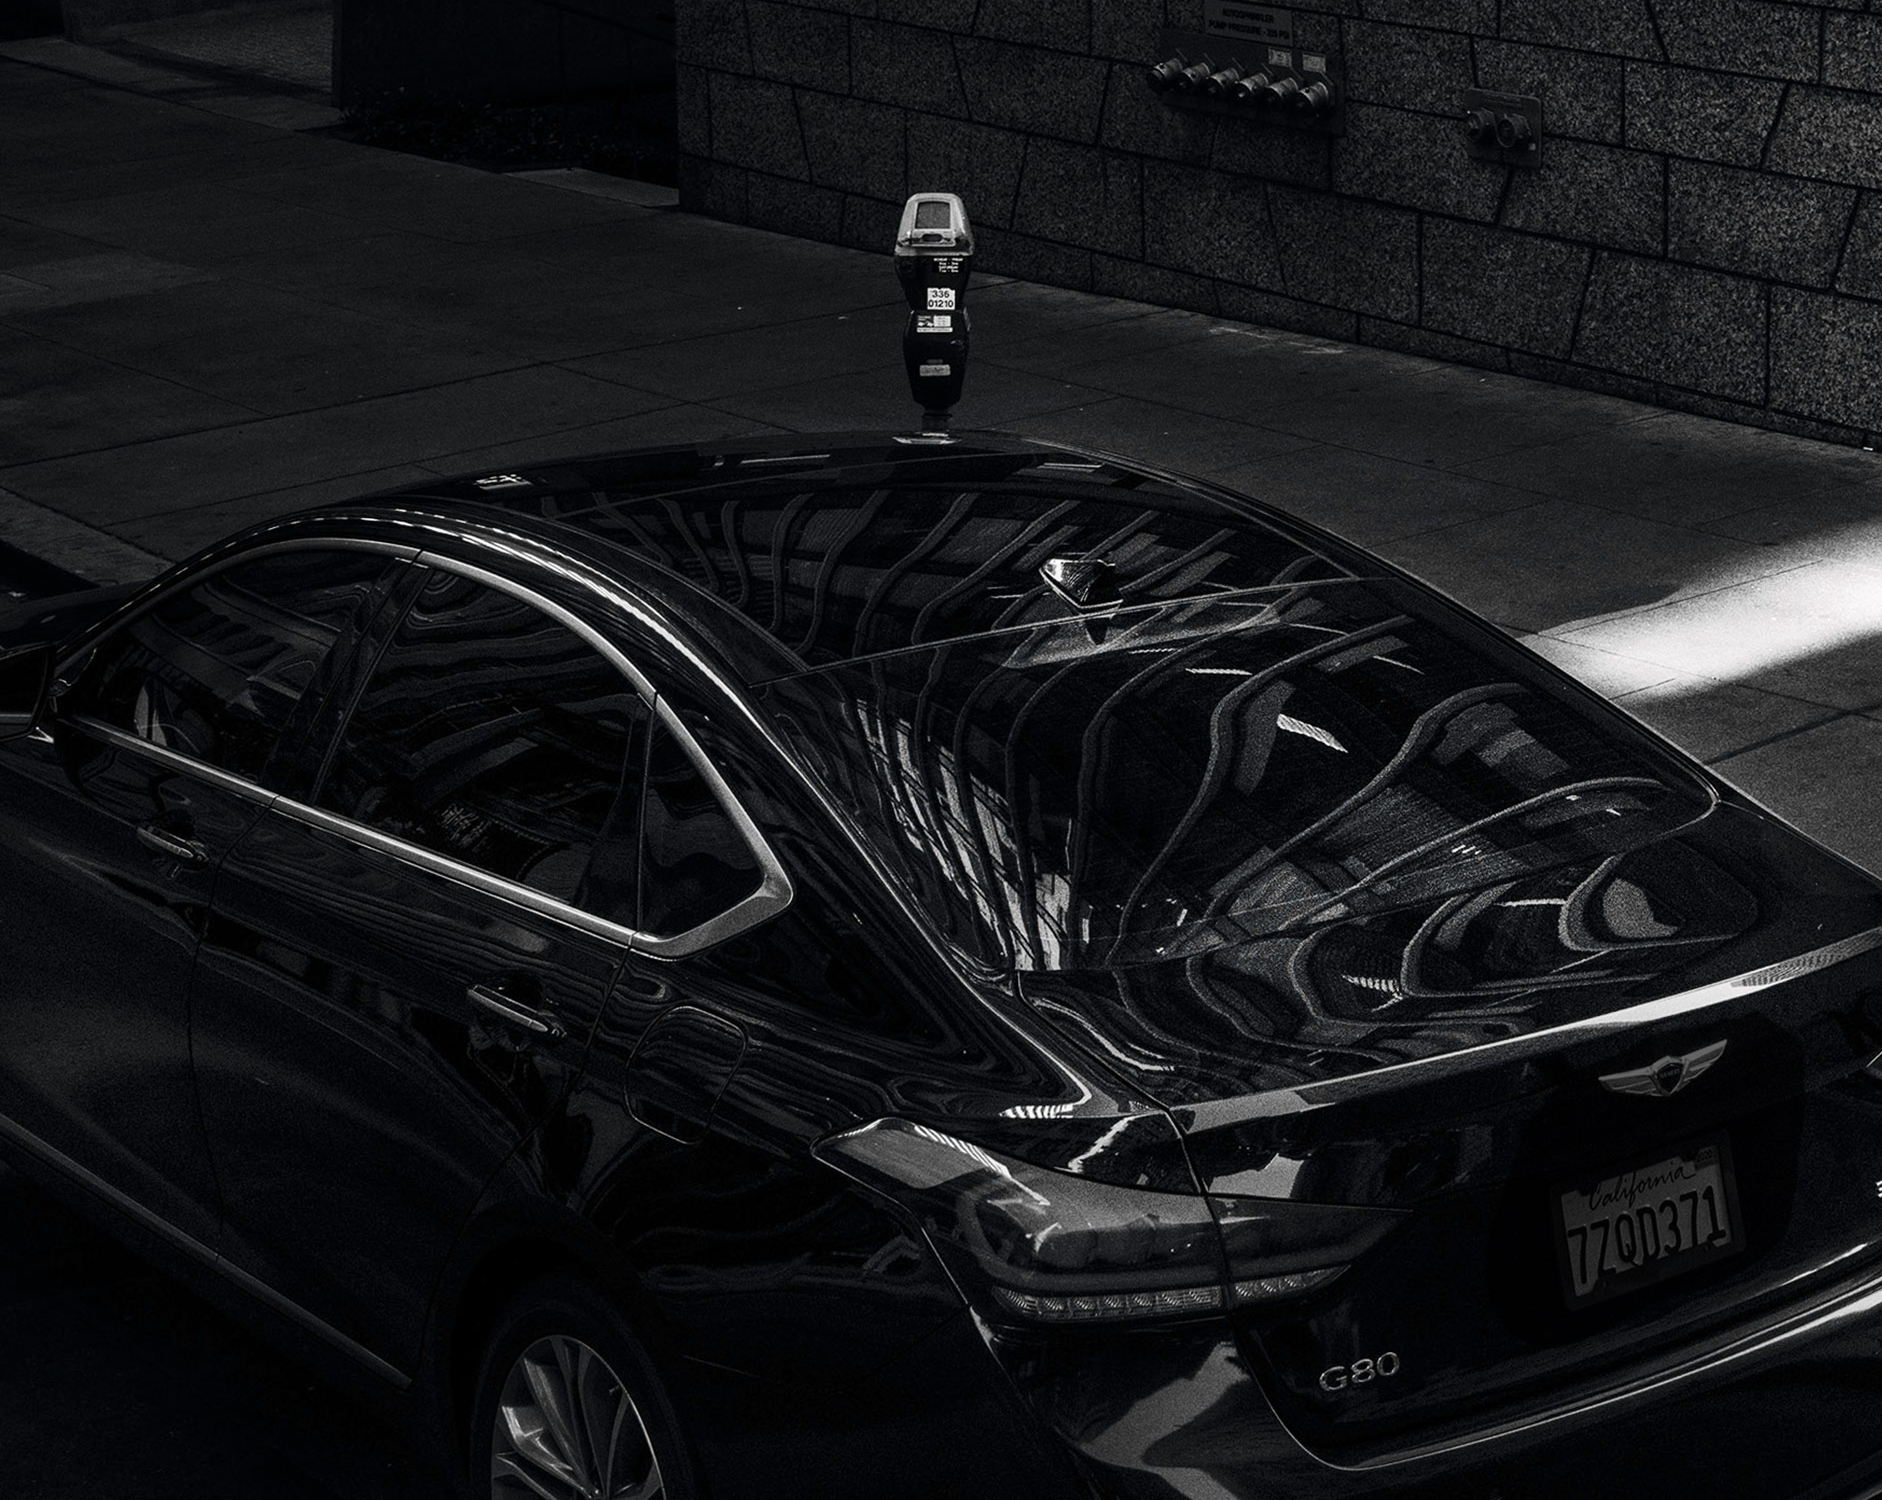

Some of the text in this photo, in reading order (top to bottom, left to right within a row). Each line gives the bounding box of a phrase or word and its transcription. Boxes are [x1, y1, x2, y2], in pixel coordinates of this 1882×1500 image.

[928, 299, 954, 308] 01210
[932, 289, 950, 298] 336
[1588, 1159, 1697, 1210] California
[1567, 1184, 1727, 1285] 7ZQD371
[1318, 1351, 1401, 1392] G80
